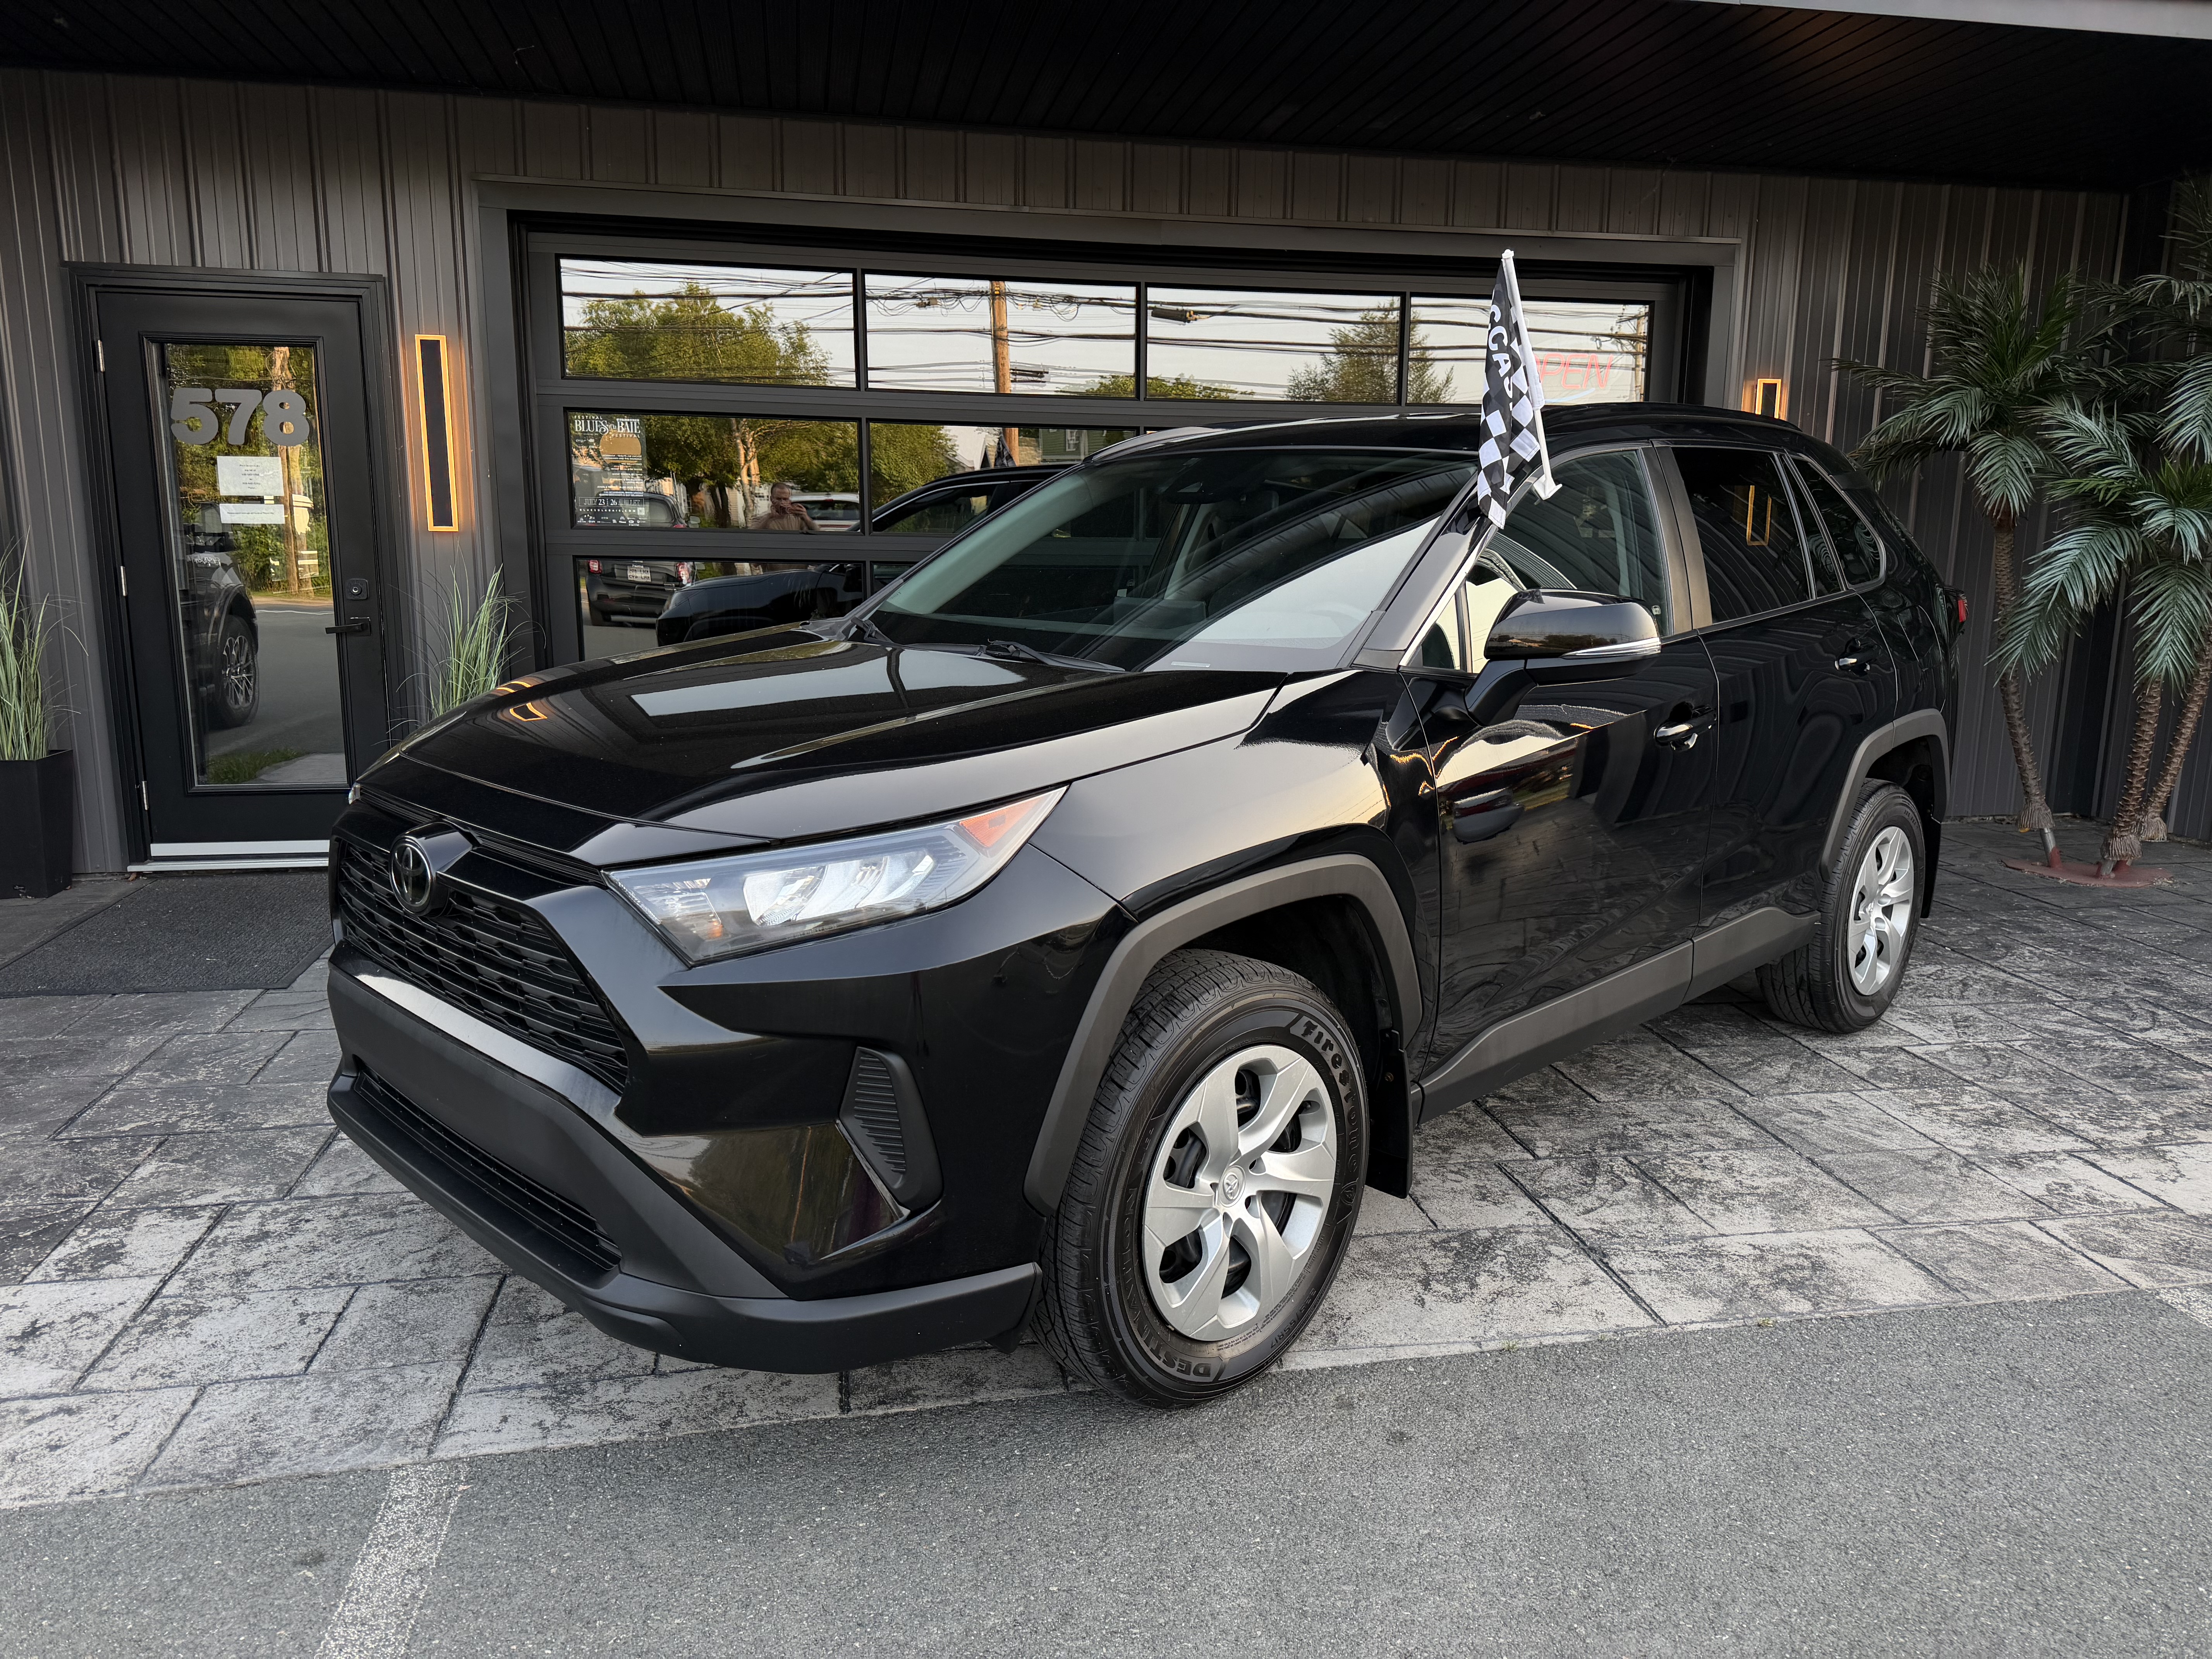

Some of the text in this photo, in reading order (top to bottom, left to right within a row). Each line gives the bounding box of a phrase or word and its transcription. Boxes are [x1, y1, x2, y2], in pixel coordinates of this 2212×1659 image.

[1534, 352, 1614, 389] PEN
[171, 388, 310, 446] 578
[575, 419, 609, 435] BLUES
[617, 421, 641, 433] BAIE
[1301, 1020, 1358, 1173] Firestone
[1122, 1188, 1211, 1377] DESTINATION
